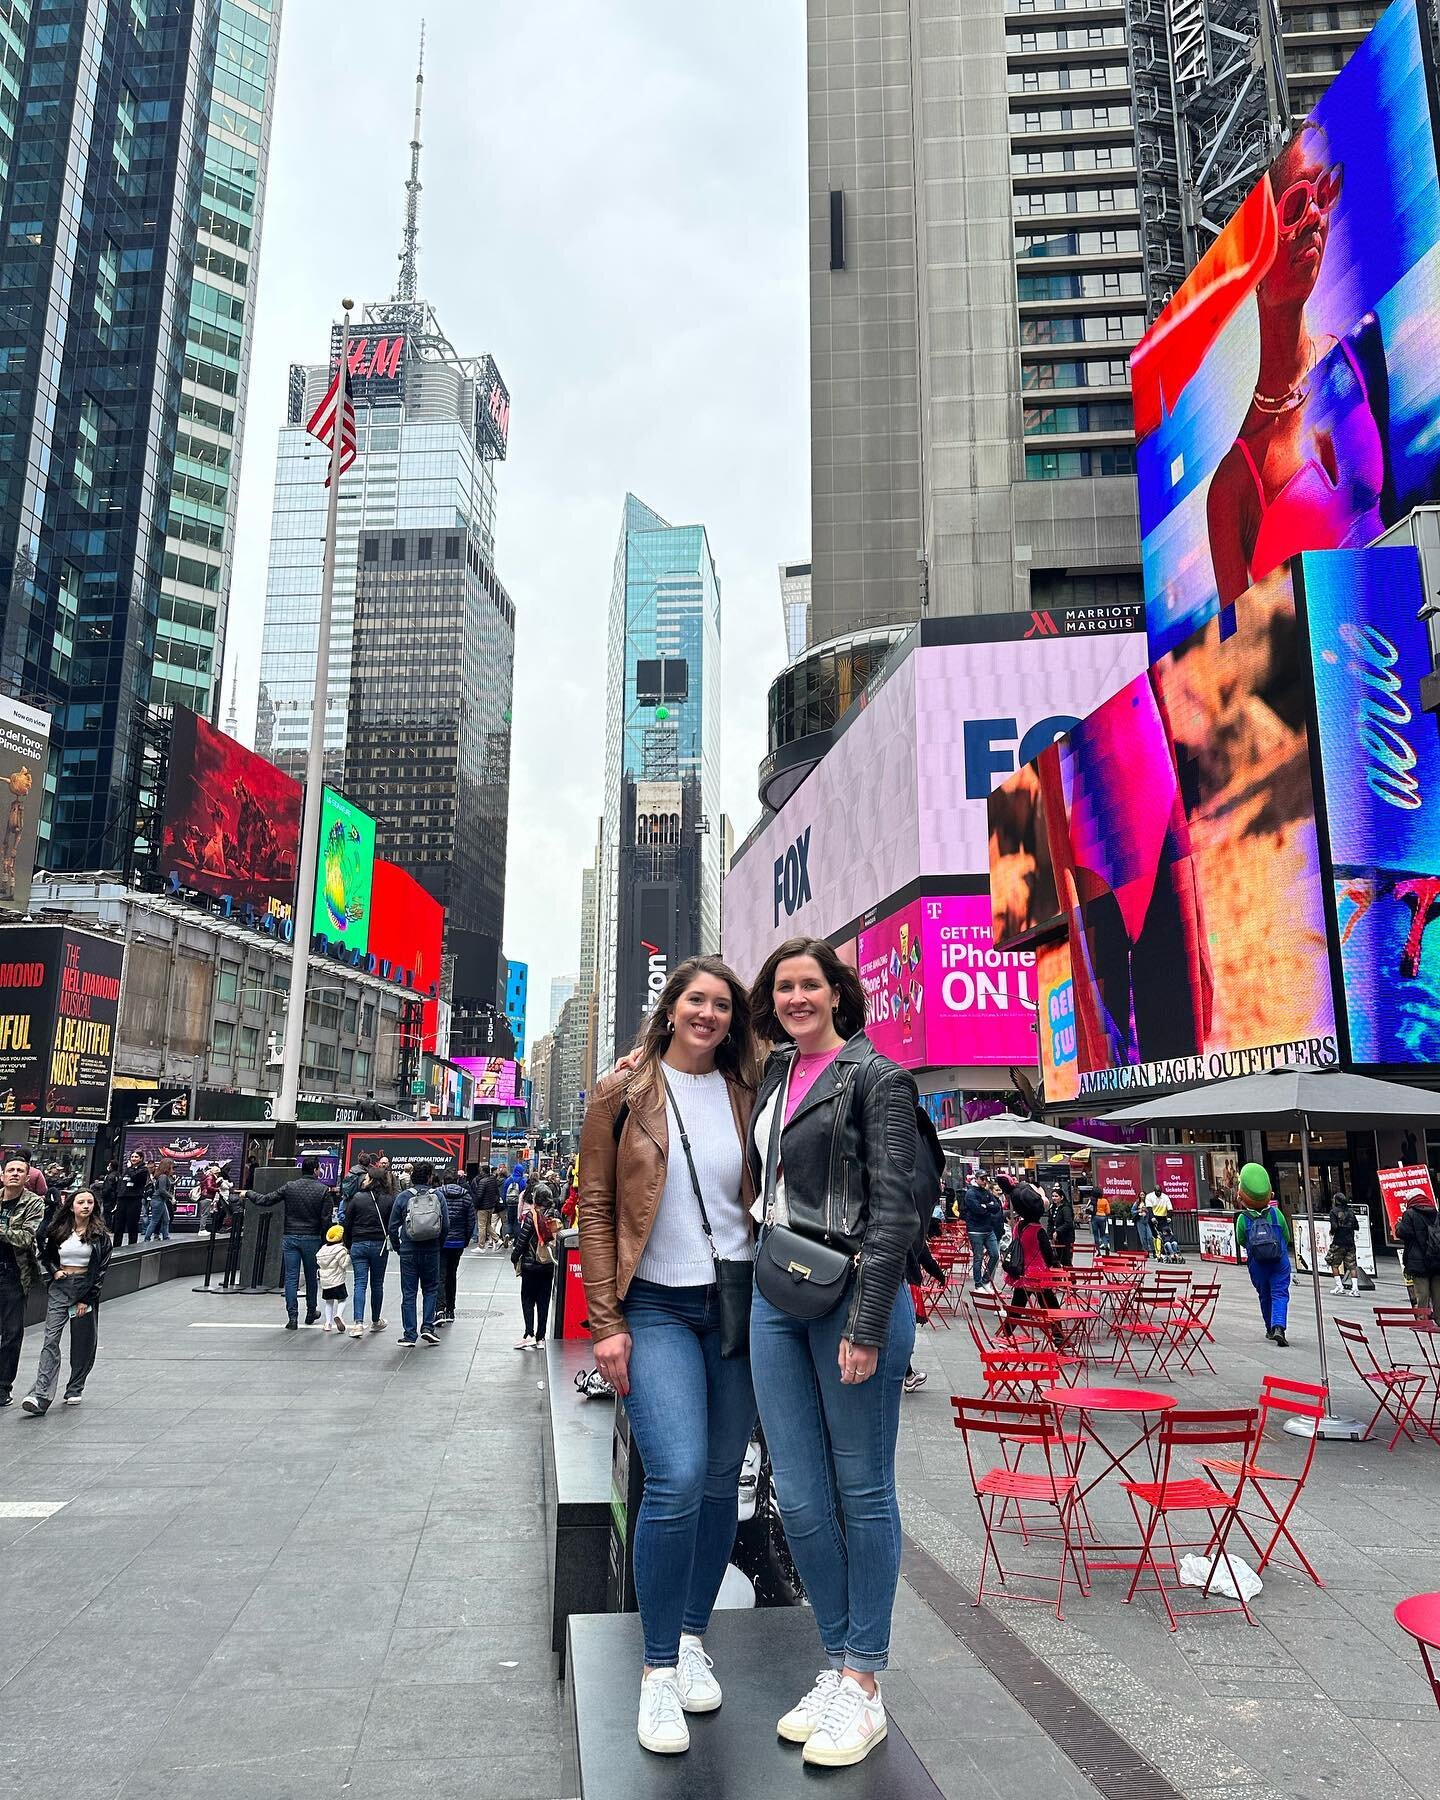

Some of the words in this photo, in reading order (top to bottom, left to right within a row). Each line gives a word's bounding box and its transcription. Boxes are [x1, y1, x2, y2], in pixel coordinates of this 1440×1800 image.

[1170, 0, 1207, 83] AM
[1065, 605, 1141, 620] MARRIOTT
[1065, 618, 1133, 632] MARQUIS
[13, 709, 25, 720] Now
[34, 719, 46, 728] view
[1322, 622, 1423, 811] aerie
[6, 729, 20, 742] del
[21, 734, 43, 751] Toro:
[774, 824, 812, 929] FOX
[268, 896, 281, 918] LIFE
[940, 926, 968, 940] GET
[971, 926, 993, 940] TH
[65, 944, 80, 969] THE
[941, 943, 1036, 968] iPhone
[61, 967, 80, 993] NEIL
[81, 971, 119, 1001] DIAMOND
[881, 967, 889, 987] 14
[942, 971, 1009, 1011] ON
[1017, 971, 1037, 1011] U
[59, 990, 91, 1018] MUSICAL
[876, 988, 889, 1023] US
[54, 1016, 63, 1050] A
[63, 1017, 110, 1057] BEAUTIFUL
[50, 1051, 80, 1087] NOISE
[1080, 1064, 1150, 1094] AMERICAN
[1154, 1056, 1205, 1085] EAGLE
[1209, 1036, 1338, 1078] OUTFITTERS
[1114, 1177, 1132, 1187] Broadway
[1379, 1171, 1407, 1180] BROADWAY
[1407, 1168, 1427, 1176] SHOWS
[1382, 1181, 1408, 1189] SPORTING
[1408, 1177, 1428, 1186] EVENTS
